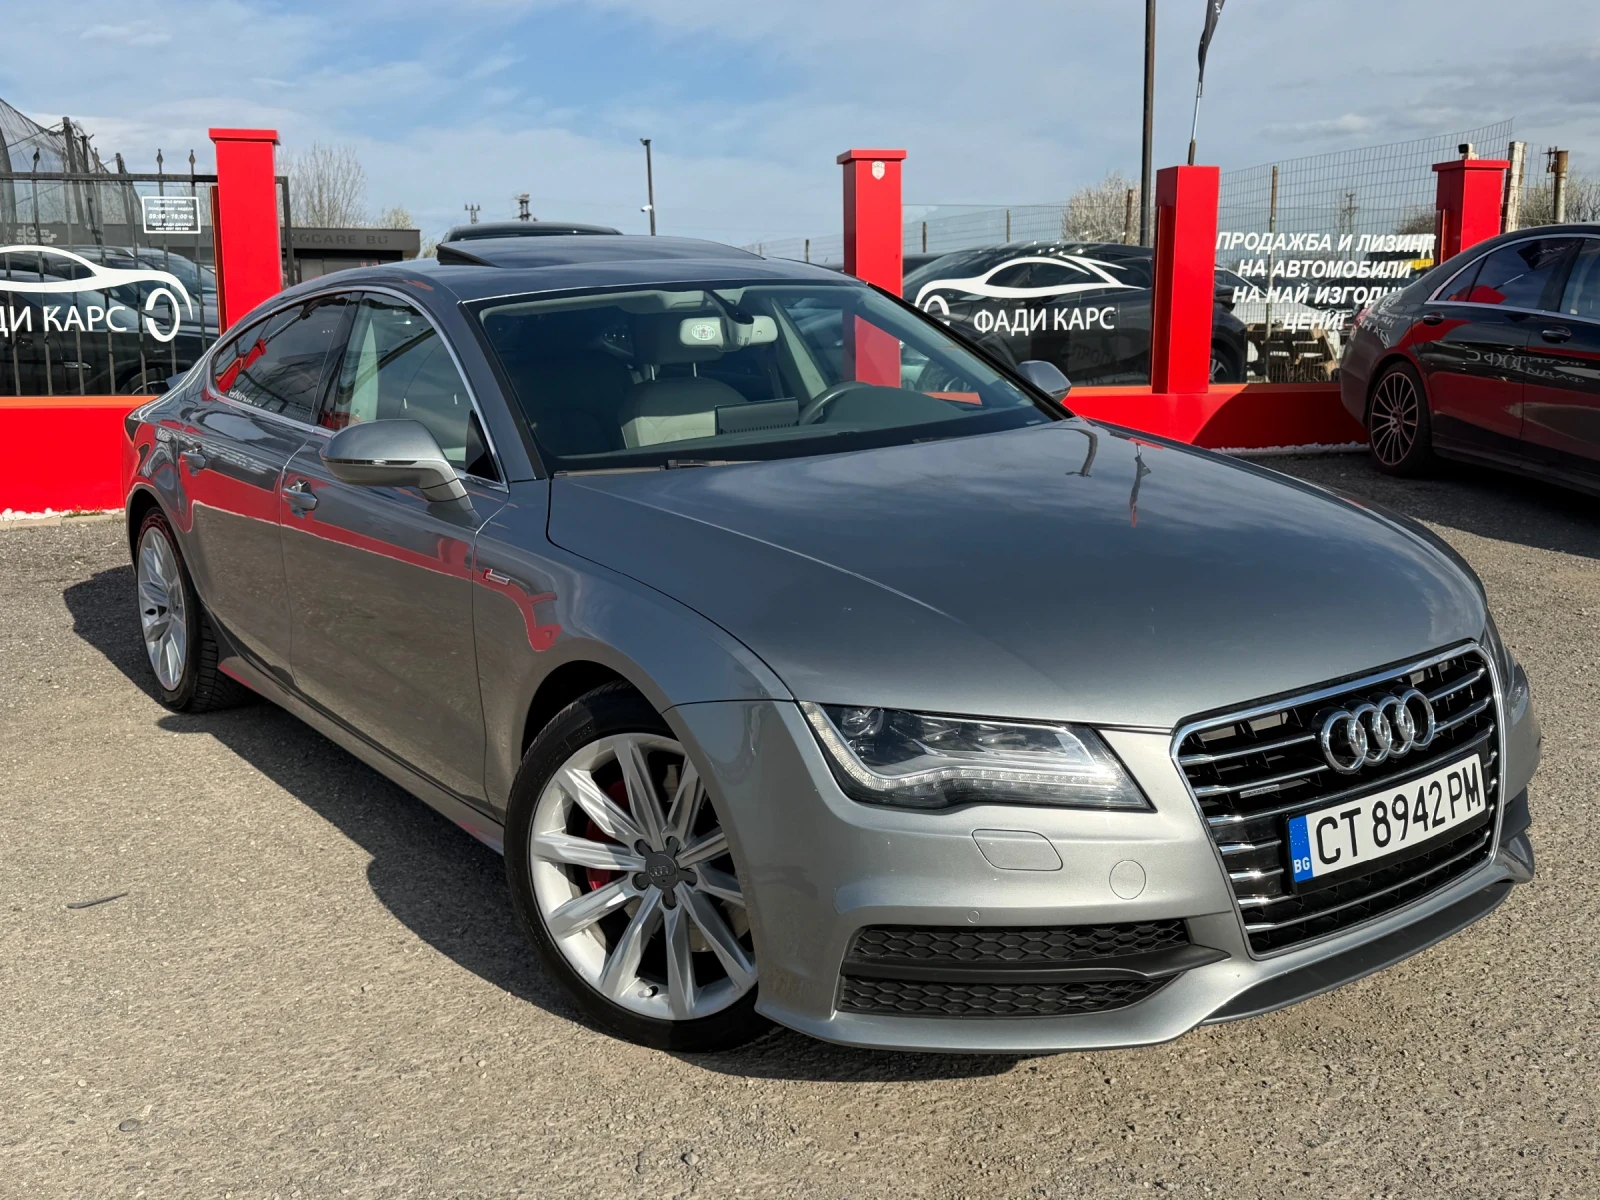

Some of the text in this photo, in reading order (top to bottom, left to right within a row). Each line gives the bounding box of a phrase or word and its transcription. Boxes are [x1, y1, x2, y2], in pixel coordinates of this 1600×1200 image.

[1215, 232, 1332, 255] ПРОДАЖБА
[1337, 234, 1353, 251] И
[1238, 259, 1413, 279] НА АВТОМОБИЛИ
[1232, 282, 1403, 308] НА НАЙ ИЗГОД
[43, 305, 128, 332] КАРС
[973, 306, 1116, 337] ФАДИ КАРС
[1283, 312, 1346, 334] ЦЕНИ!
[1371, 780, 1446, 848] 8942
[1293, 857, 1311, 874] BG
